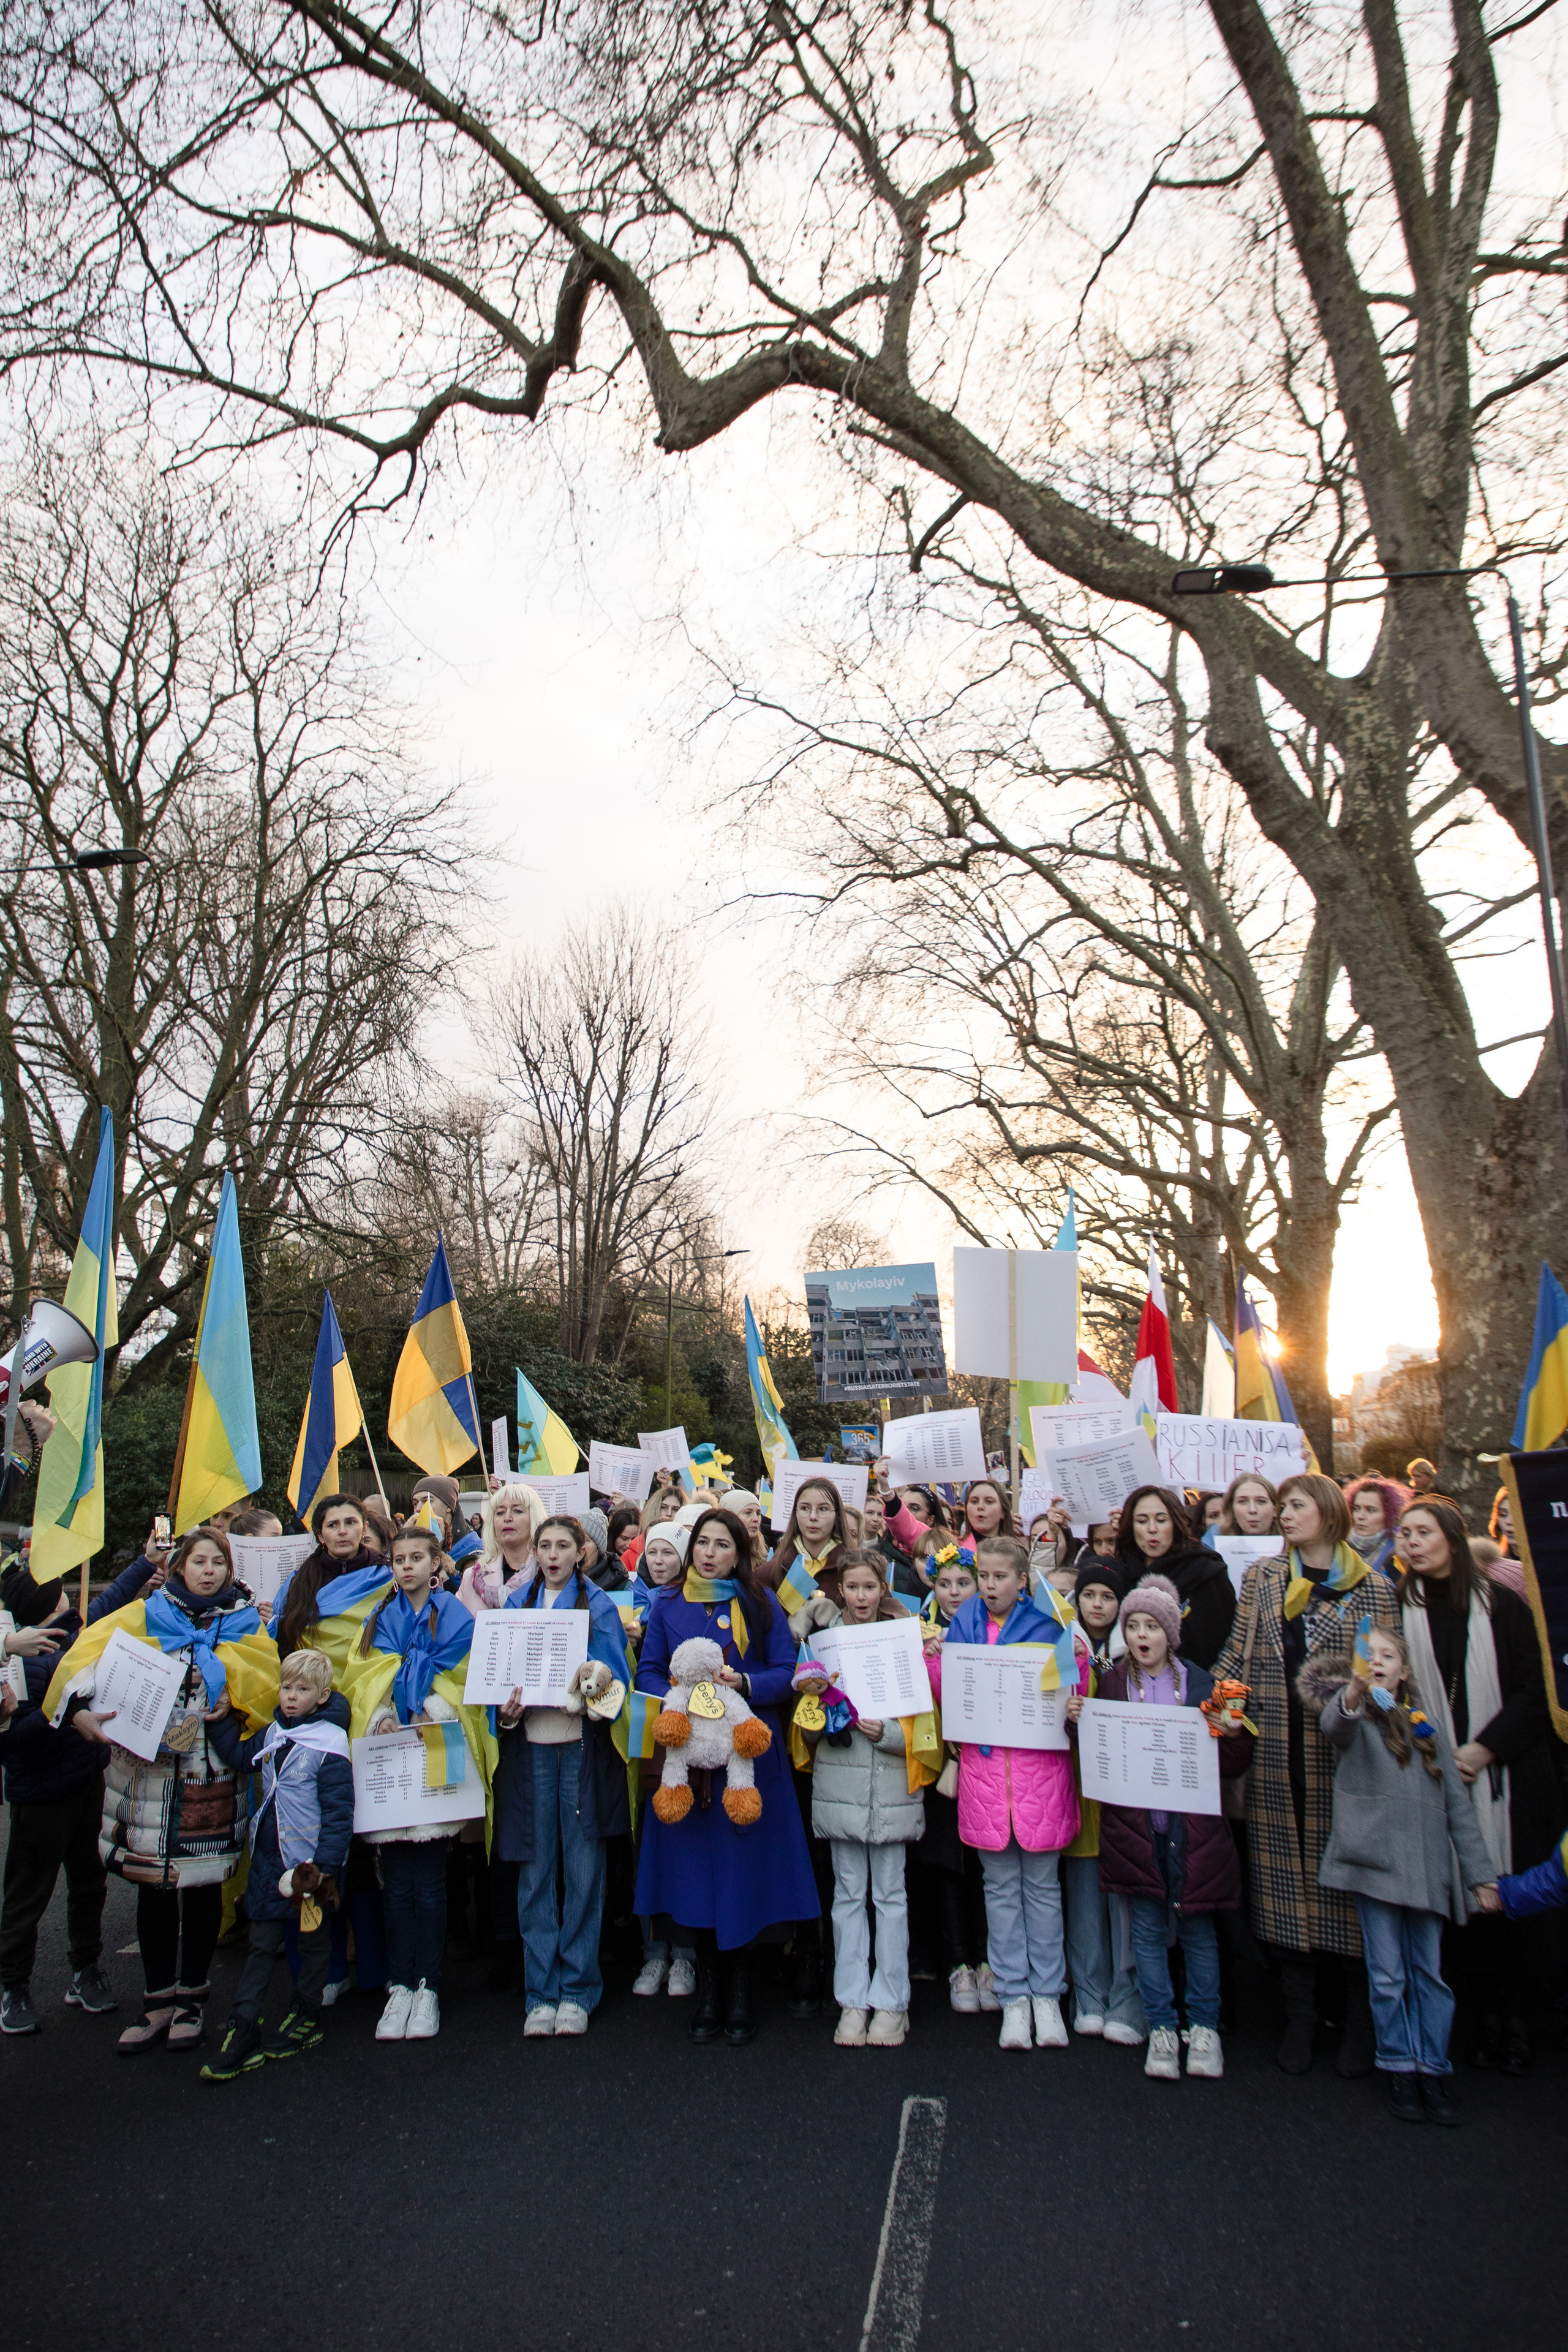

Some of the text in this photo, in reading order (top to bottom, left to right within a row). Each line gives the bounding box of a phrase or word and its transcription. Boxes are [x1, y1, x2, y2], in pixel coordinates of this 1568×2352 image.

[836, 1276, 905, 1292] Mykolayiv
[23, 1342, 48, 1365] TAND WITH
[24, 1348, 53, 1371] UKRAINE
[844, 1381, 921, 1392] #RUSSIAISATERRORISTSTATE
[851, 1433, 870, 1446] 365
[1022, 1490, 1054, 1501] BLOOD
[590, 1687, 620, 1705] Tymur
[601, 1698, 617, 1707] Kherson
[698, 1683, 718, 1714] Denys
[168, 1720, 198, 1745] Maksym
